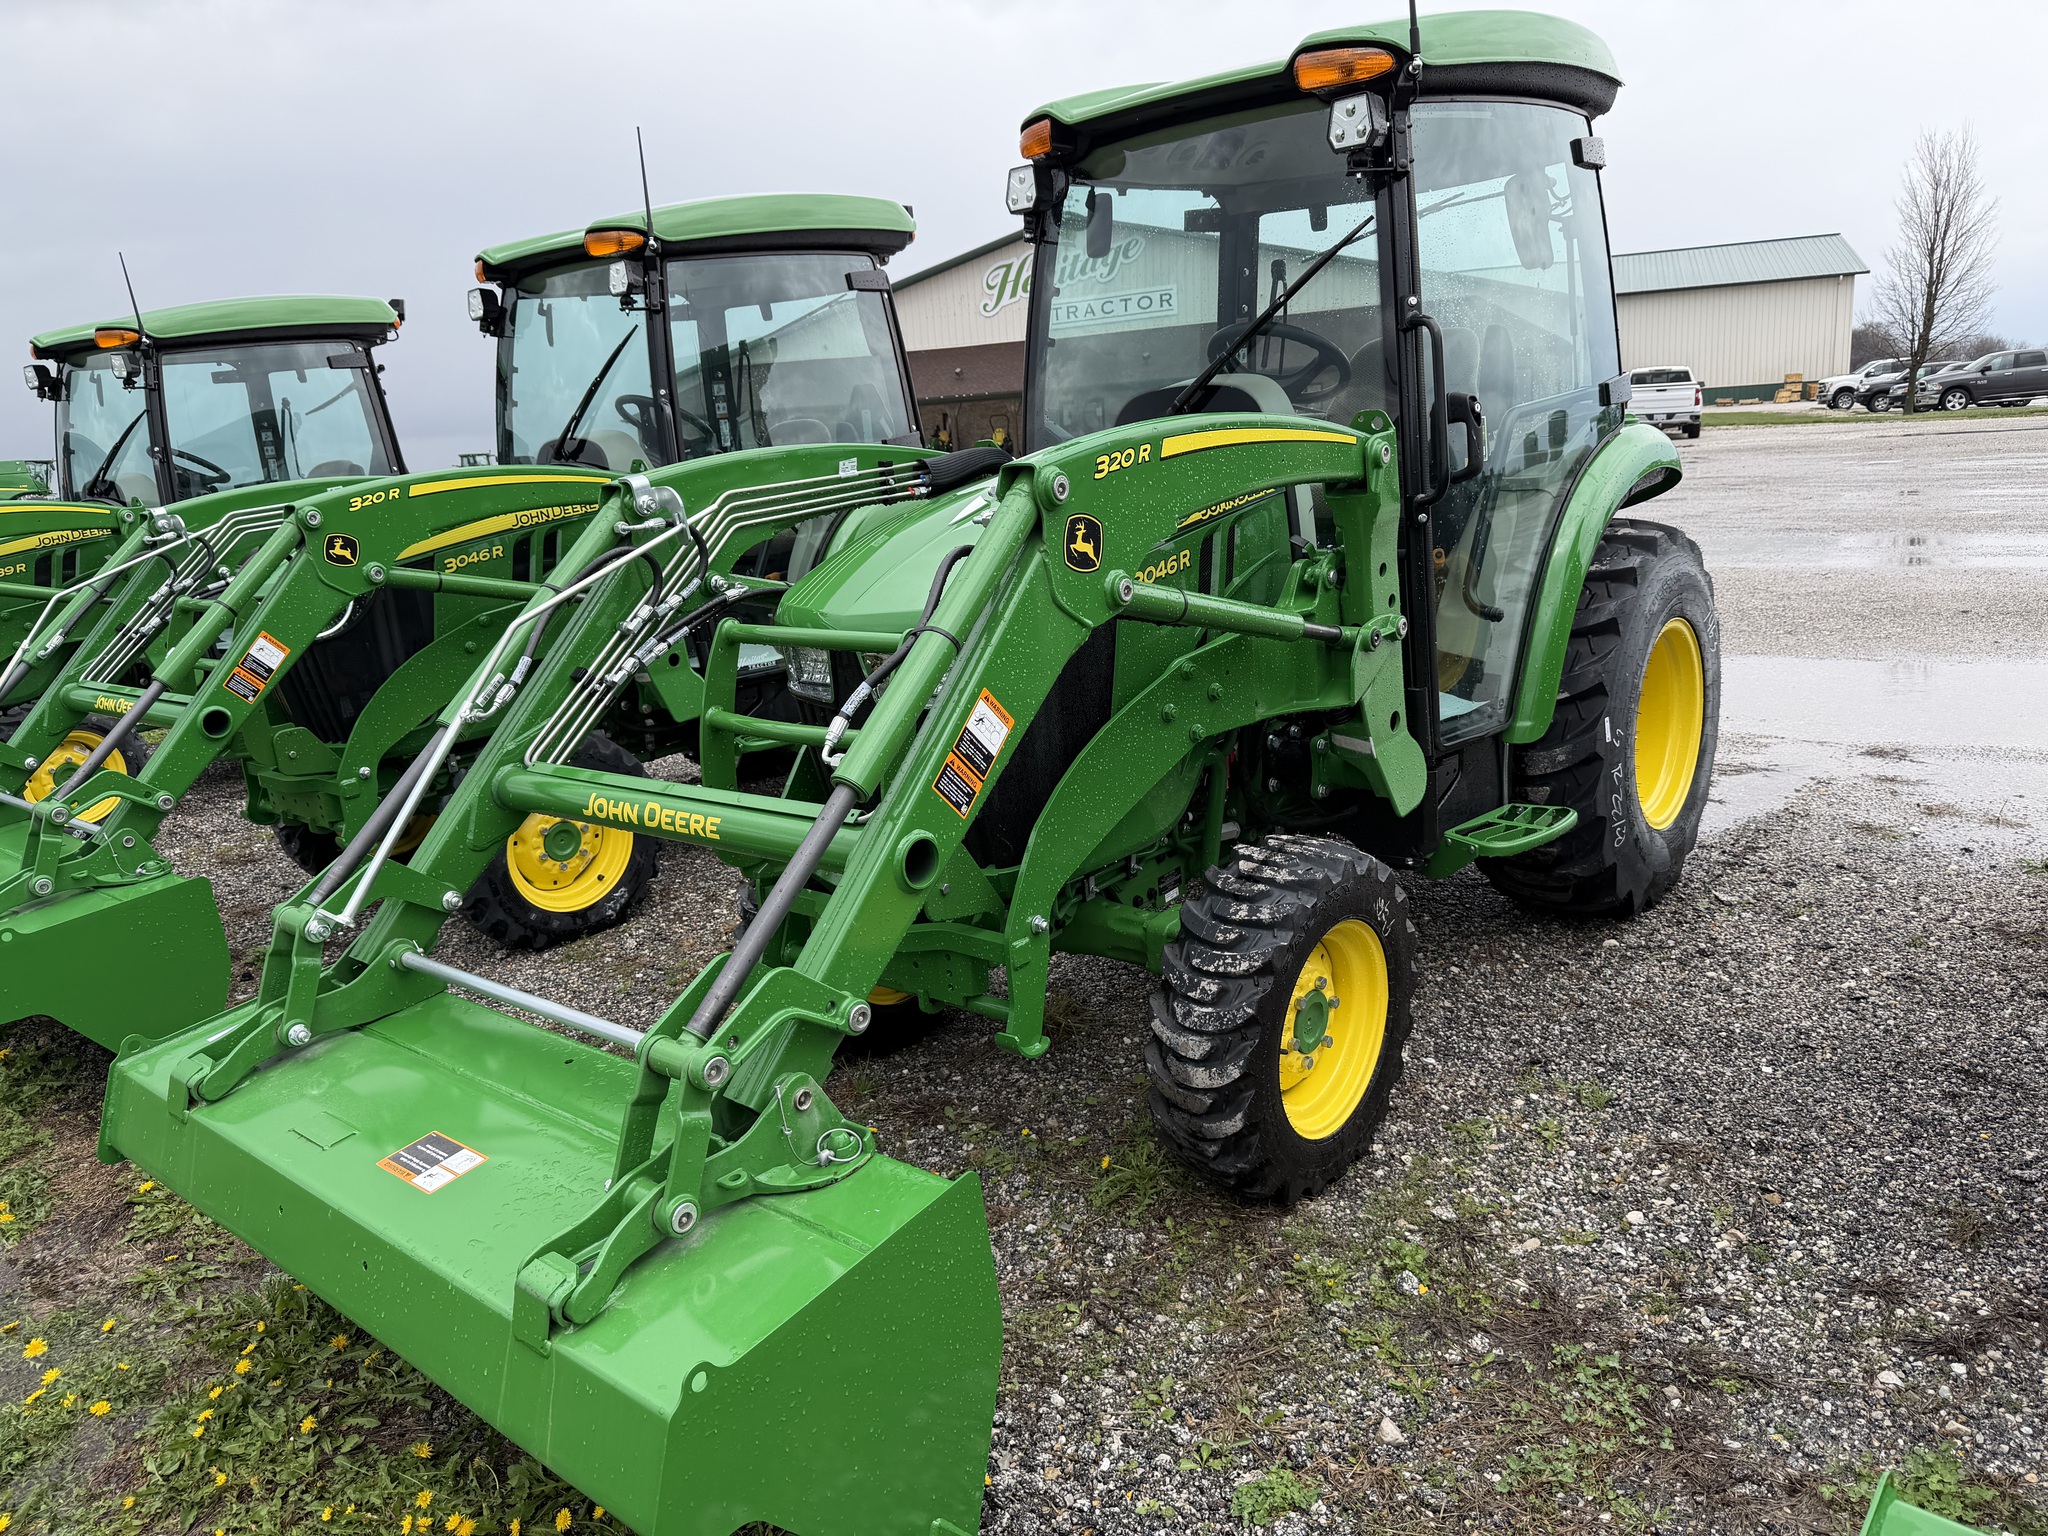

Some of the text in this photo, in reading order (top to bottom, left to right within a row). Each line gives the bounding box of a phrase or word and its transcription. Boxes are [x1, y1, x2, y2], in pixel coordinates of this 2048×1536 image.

[1052, 292, 1173, 321] TRACTOR
[1094, 443, 1151, 479] 320 R
[349, 487, 400, 512] 320 R
[511, 508, 551, 528] JOHN
[35, 532, 70, 548] JOHN
[16, 563, 27, 574] R
[444, 545, 504, 573] 3046 R
[1179, 549, 1191, 571] R
[94, 694, 135, 714] JOHN DEE
[989, 698, 1010, 725] WARNING
[955, 764, 978, 789] WARNING
[582, 792, 722, 840] JOHN DEERE
